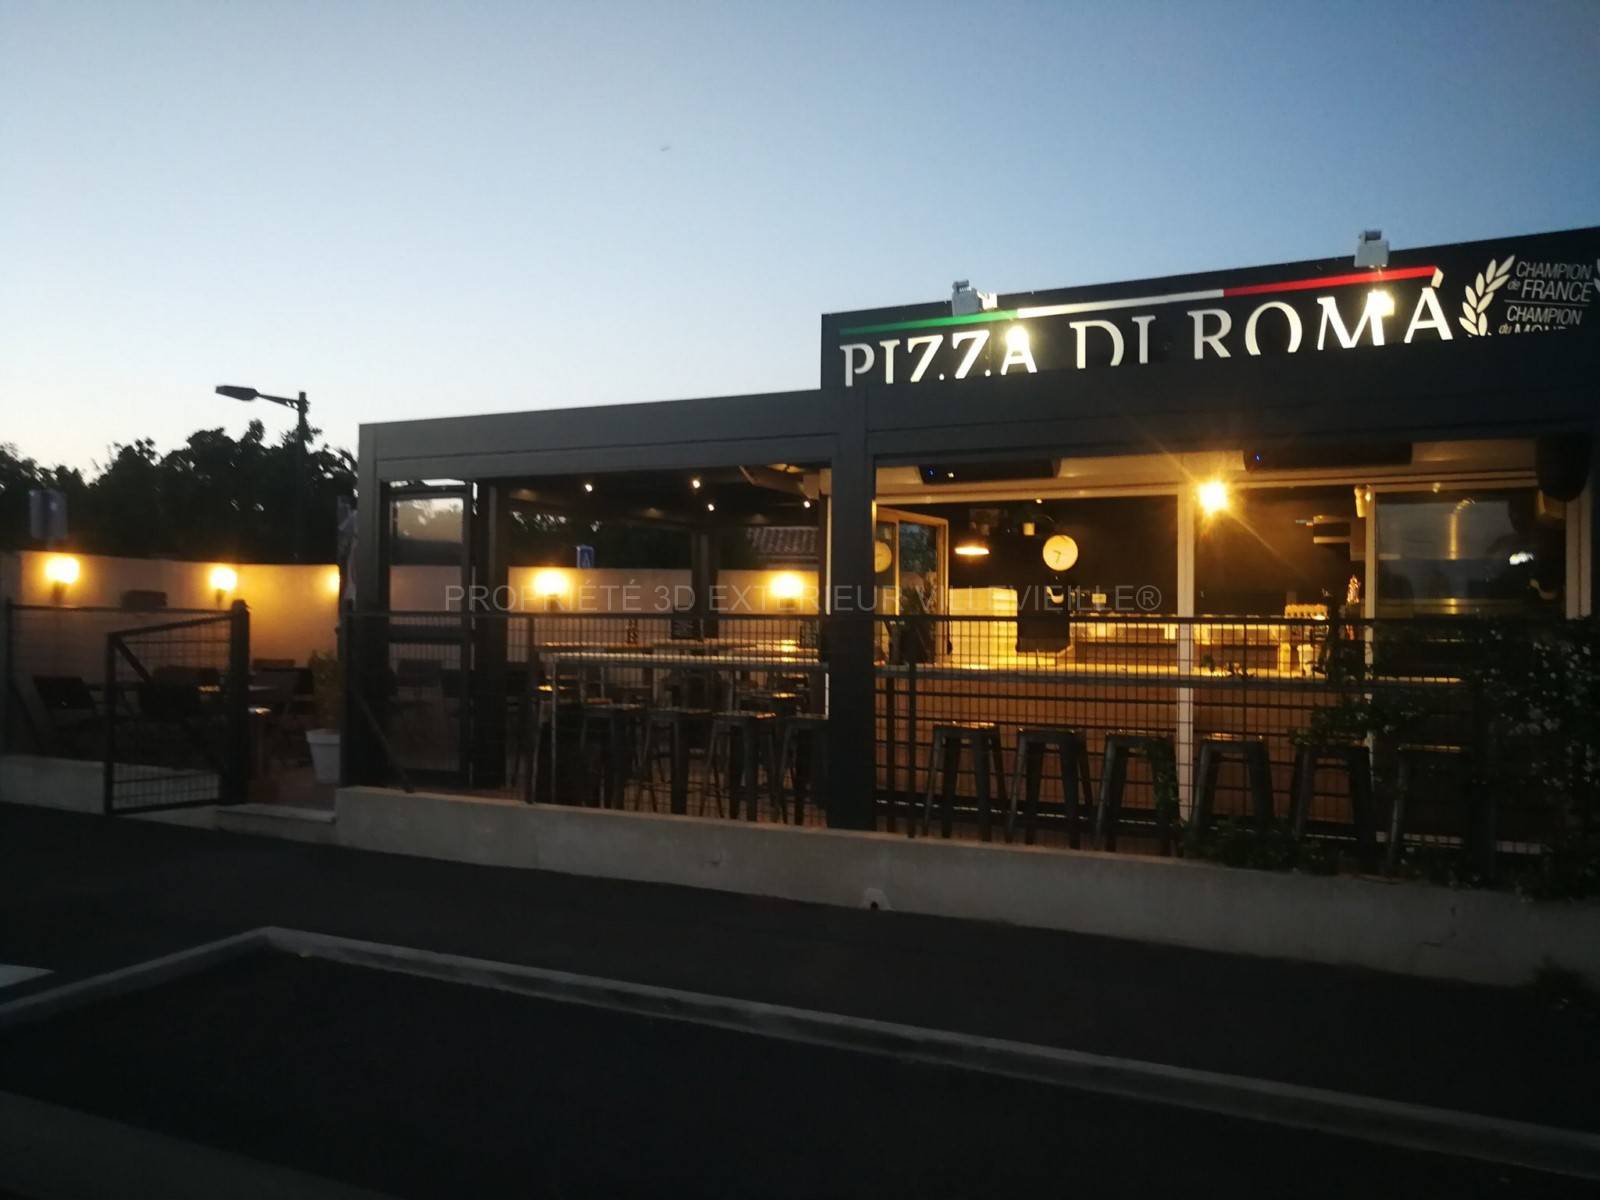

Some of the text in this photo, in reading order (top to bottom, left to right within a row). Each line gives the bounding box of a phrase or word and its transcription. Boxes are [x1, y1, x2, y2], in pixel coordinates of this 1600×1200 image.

[1516, 261, 1592, 280] CHAMPION
[1521, 279, 1593, 302] FRANCE
[1506, 305, 1582, 325] CHAMPION
[839, 327, 1038, 387] PIZZA
[1069, 315, 1156, 370] DI
